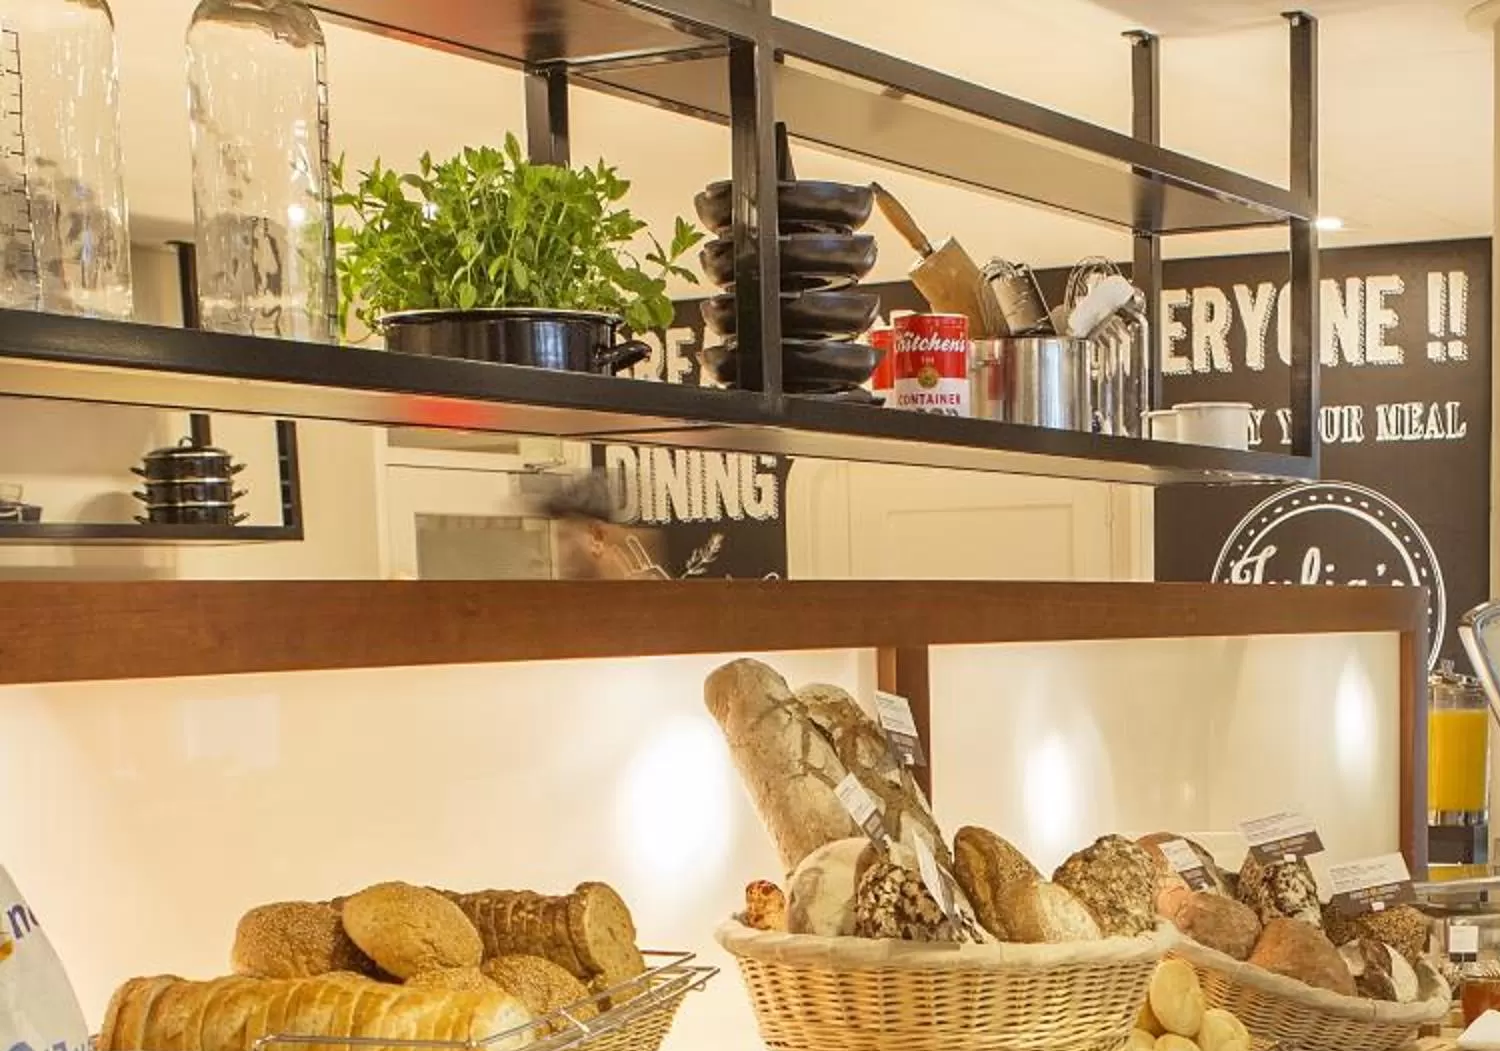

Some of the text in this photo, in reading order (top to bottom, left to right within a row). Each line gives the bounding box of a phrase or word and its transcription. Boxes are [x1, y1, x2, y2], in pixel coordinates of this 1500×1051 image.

[1160, 275, 1405, 375] ERYNE
[1276, 406, 1365, 444] YUR
[1376, 402, 1467, 441] MEAL
[605, 444, 780, 524] DINING
